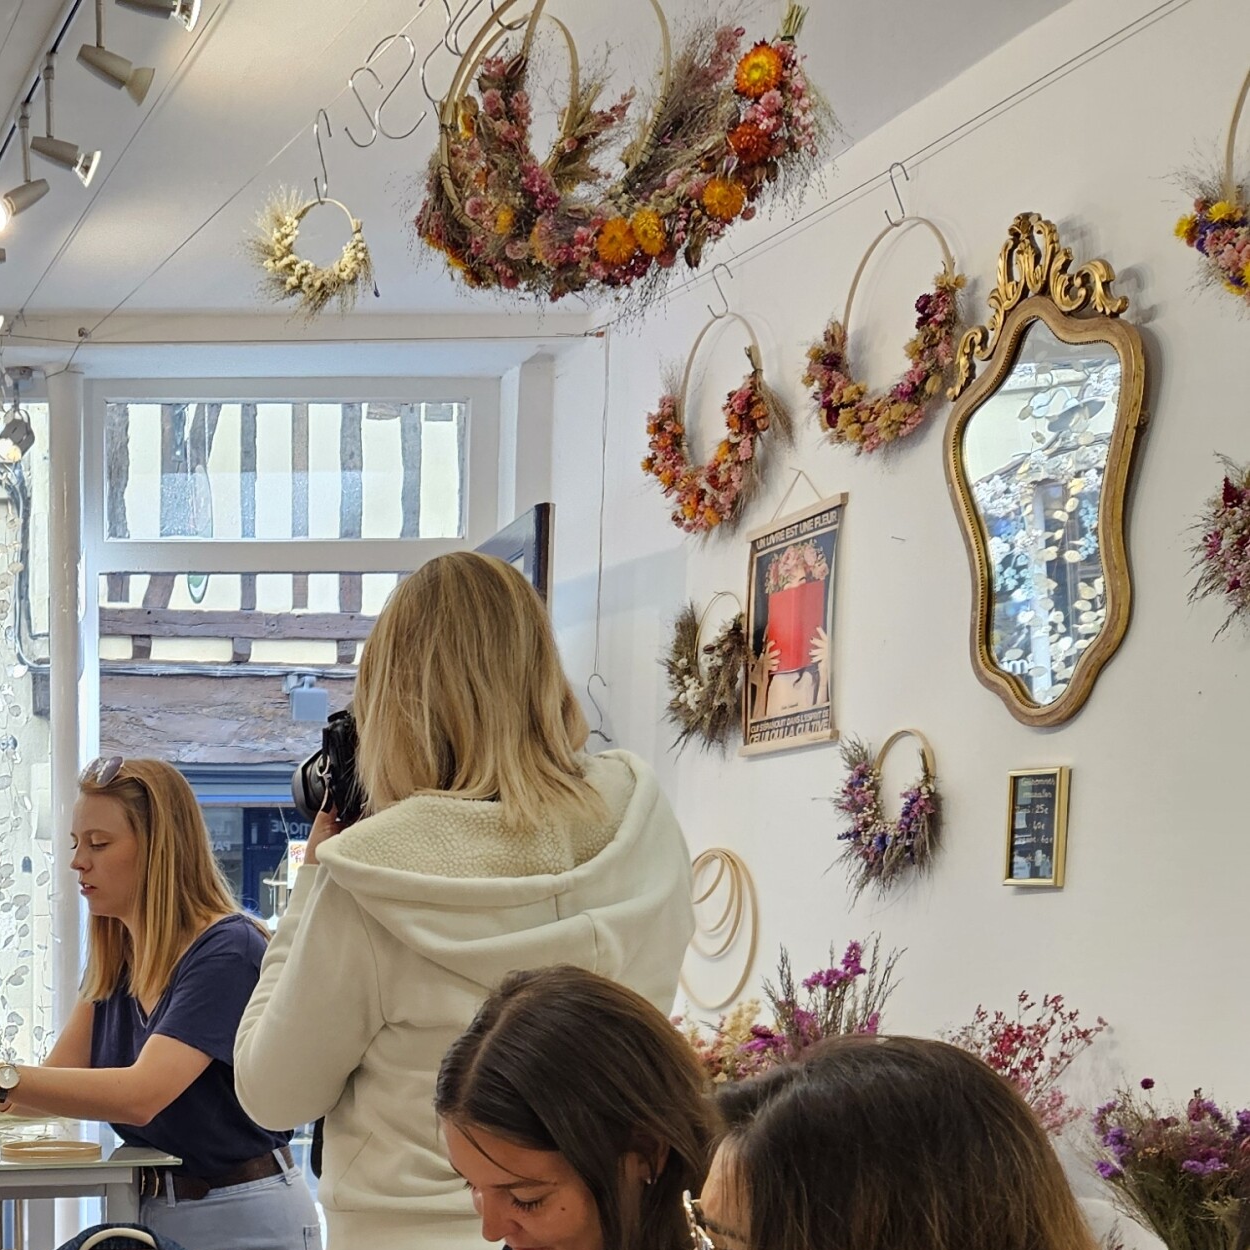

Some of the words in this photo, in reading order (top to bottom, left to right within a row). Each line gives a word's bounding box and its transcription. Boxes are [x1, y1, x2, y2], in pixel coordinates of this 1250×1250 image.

[766, 530, 785, 546] LIVRE
[785, 524, 799, 539] EST
[799, 518, 814, 534] UNE
[814, 510, 837, 528] FLEUR
